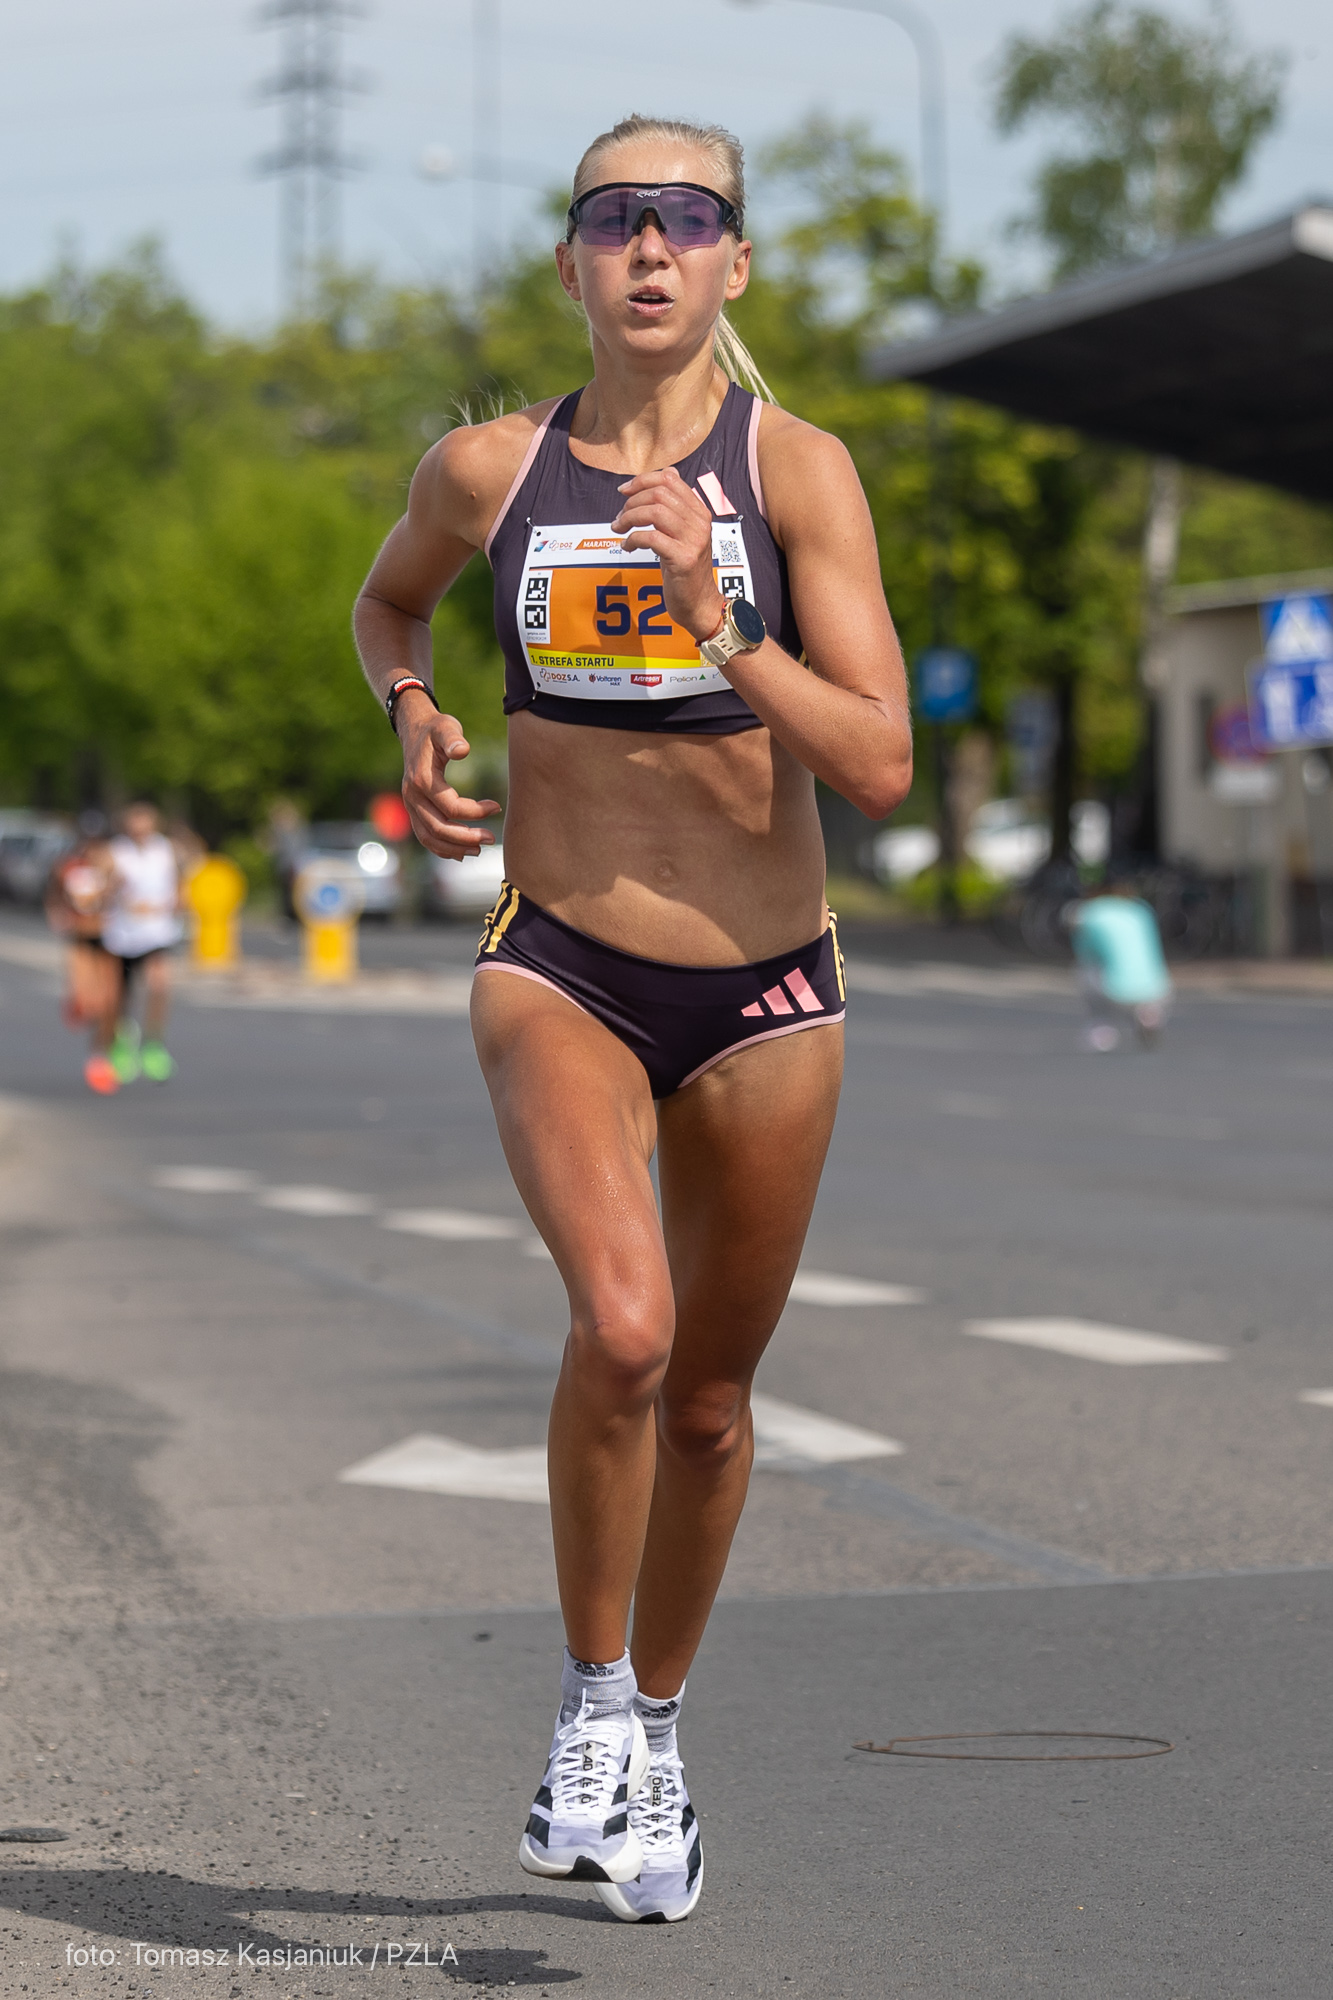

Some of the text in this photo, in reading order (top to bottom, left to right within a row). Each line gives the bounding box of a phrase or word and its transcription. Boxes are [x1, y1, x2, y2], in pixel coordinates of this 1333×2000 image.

[583, 540, 616, 548] MARATON
[596, 585, 673, 636] 52
[530, 655, 615, 667] 1. STREFA STARTU
[550, 673, 567, 681] DOZ
